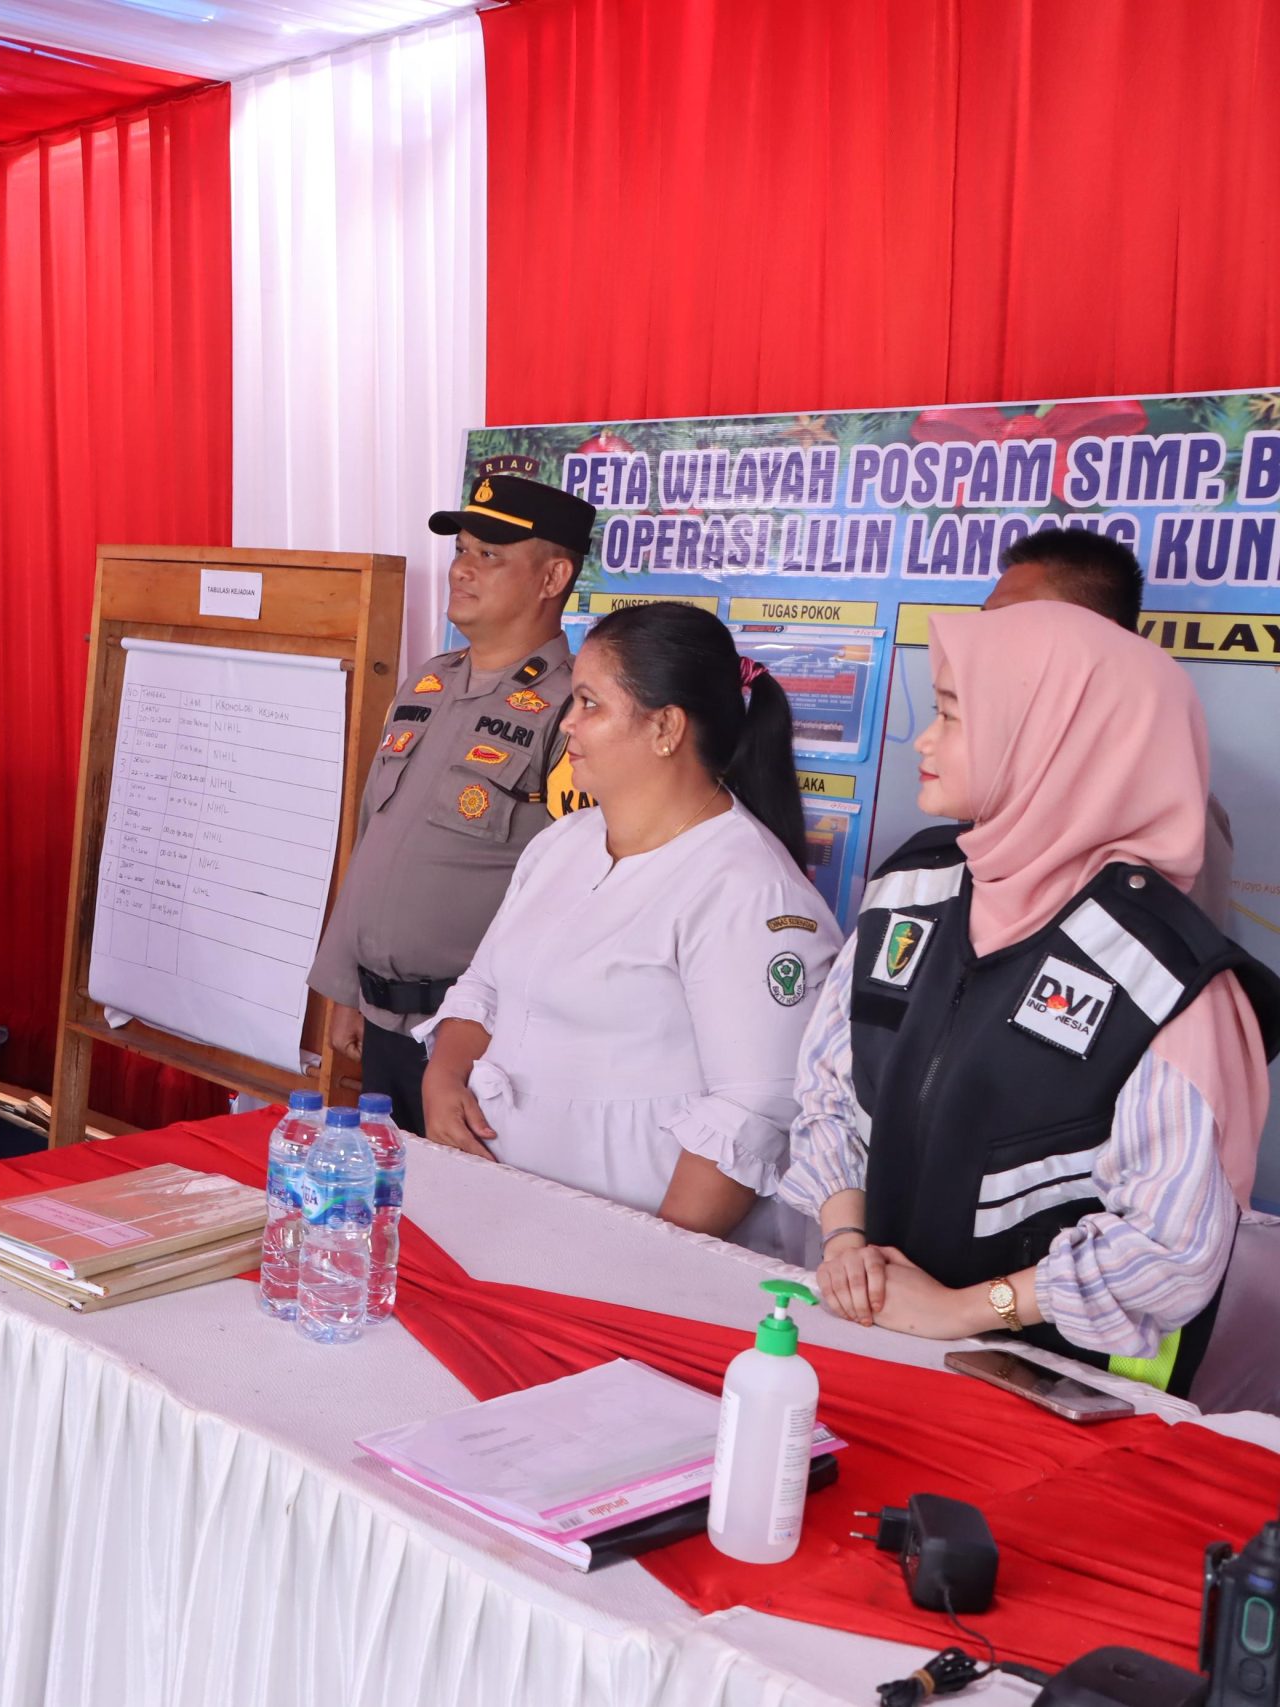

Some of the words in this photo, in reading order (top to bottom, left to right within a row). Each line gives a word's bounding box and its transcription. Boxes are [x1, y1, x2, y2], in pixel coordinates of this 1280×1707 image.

[486, 460, 533, 473] RIAU
[566, 455, 649, 505] PETA
[663, 450, 838, 505] WILAYAH
[852, 443, 1054, 503] POSPAM
[1070, 437, 1222, 502] SIMP.
[607, 518, 768, 570] OPERASI
[782, 518, 892, 574] LILIN
[1154, 517, 1280, 581] KUN
[762, 603, 798, 619] TUGAS
[801, 605, 841, 620] POKOK
[214, 721, 242, 734] NIHIL
[474, 715, 535, 749] POLRI
[213, 750, 238, 763] NIHIL
[209, 775, 237, 794] NIHIL
[206, 802, 230, 814] NIHIL
[202, 831, 223, 843] NIHIL
[198, 857, 220, 870] NIHIL
[1031, 974, 1105, 1027] DVI
